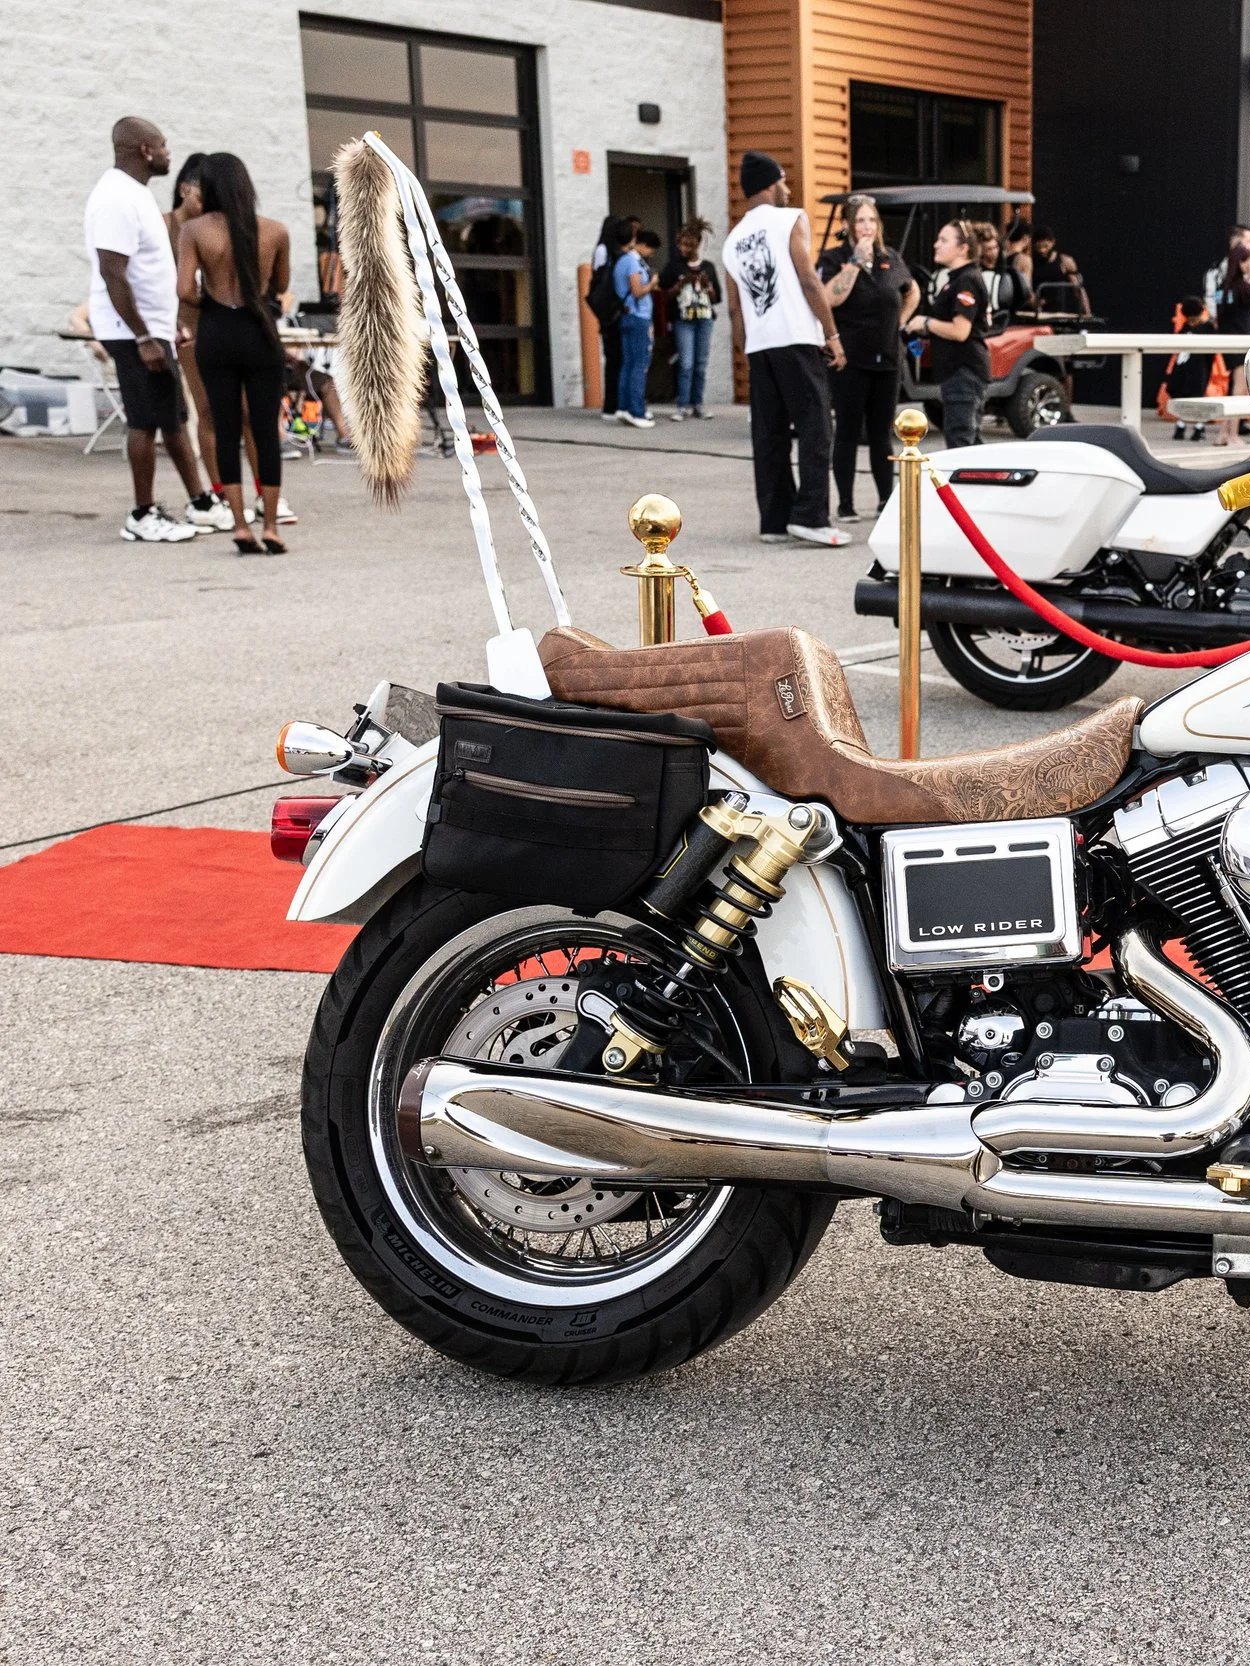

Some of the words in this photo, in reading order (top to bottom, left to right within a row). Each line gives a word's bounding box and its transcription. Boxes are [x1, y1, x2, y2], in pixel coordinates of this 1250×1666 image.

[918, 924, 964, 937] LOW
[973, 918, 1044, 932] RIDER
[388, 1232, 457, 1298] MICHELIN
[470, 1299, 554, 1326] COMMANDER
[563, 1326, 598, 1338] CRUISER
